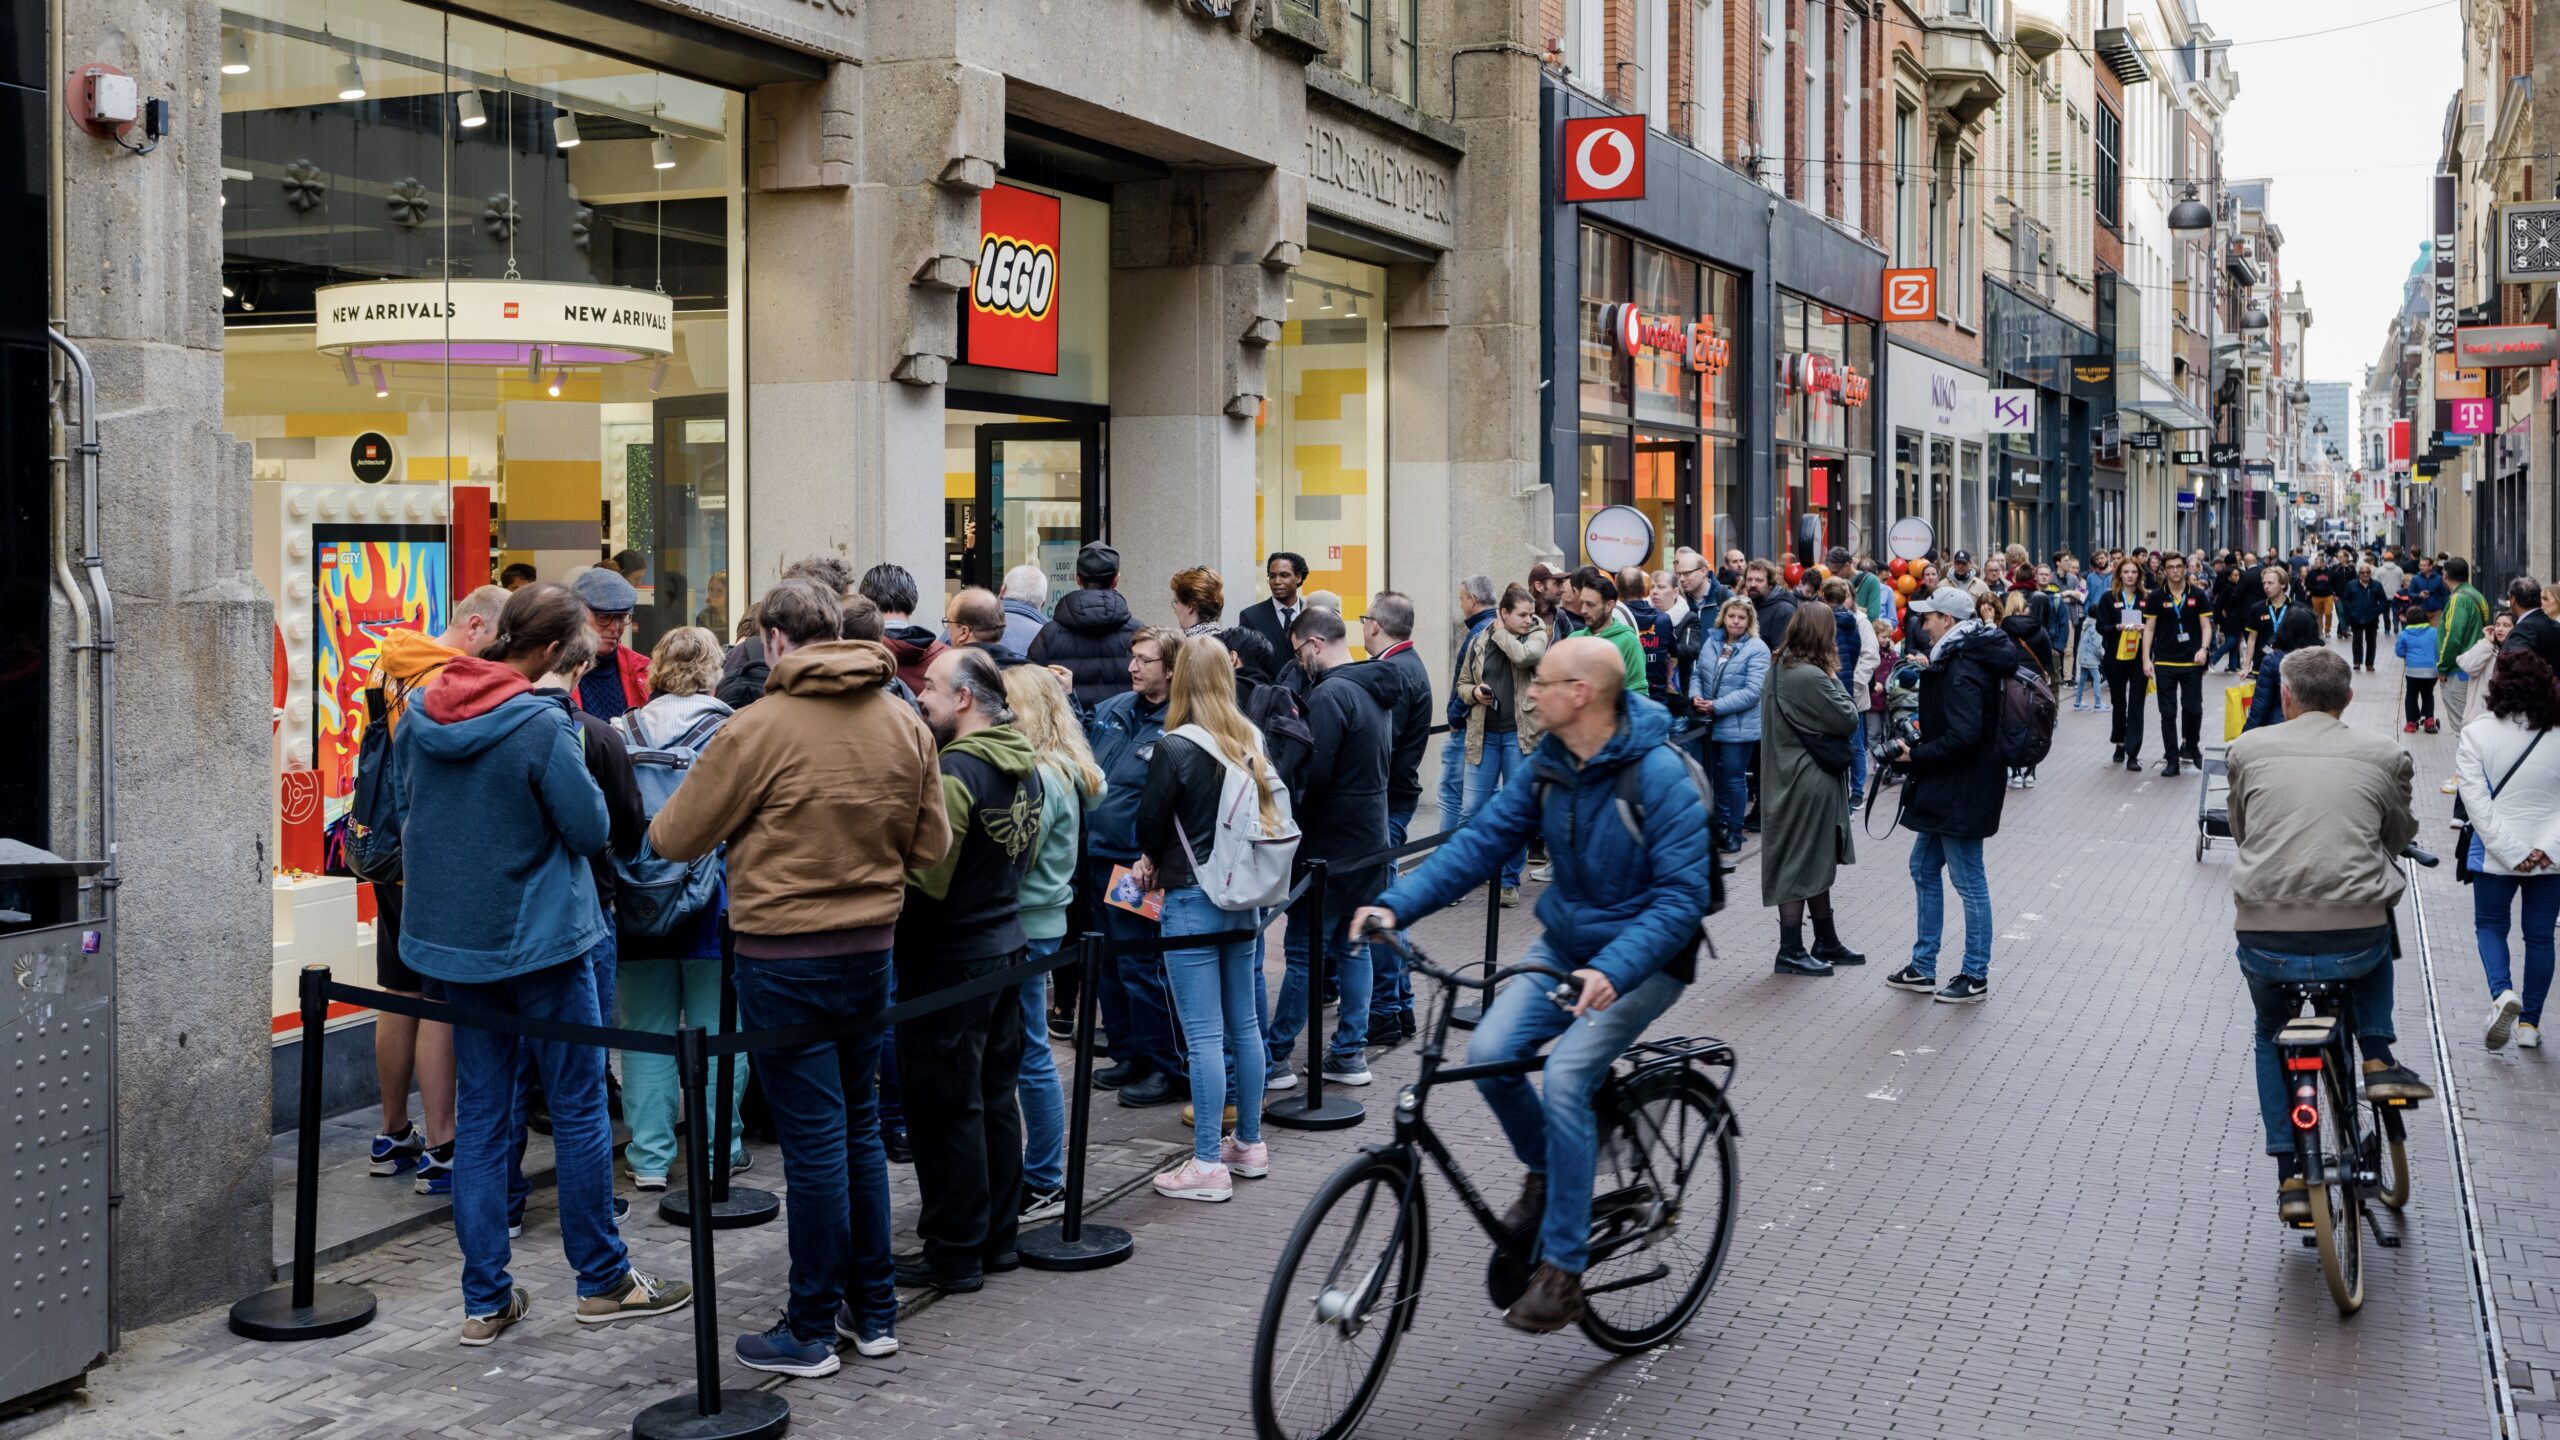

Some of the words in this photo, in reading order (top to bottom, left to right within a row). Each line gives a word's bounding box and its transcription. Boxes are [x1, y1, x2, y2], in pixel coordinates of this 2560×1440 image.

[975, 237, 1055, 316] LEGO
[333, 304, 360, 323] NEW
[364, 302, 456, 321] ARRIVALS
[564, 305, 608, 323] NEW
[612, 308, 666, 331] ARRIVALS
[1931, 373, 1957, 411] KIKO
[2181, 453, 2199, 463] WE
[321, 553, 337, 563] LEGO
[340, 551, 361, 564] CITY
[1049, 573, 1068, 582] STORE
